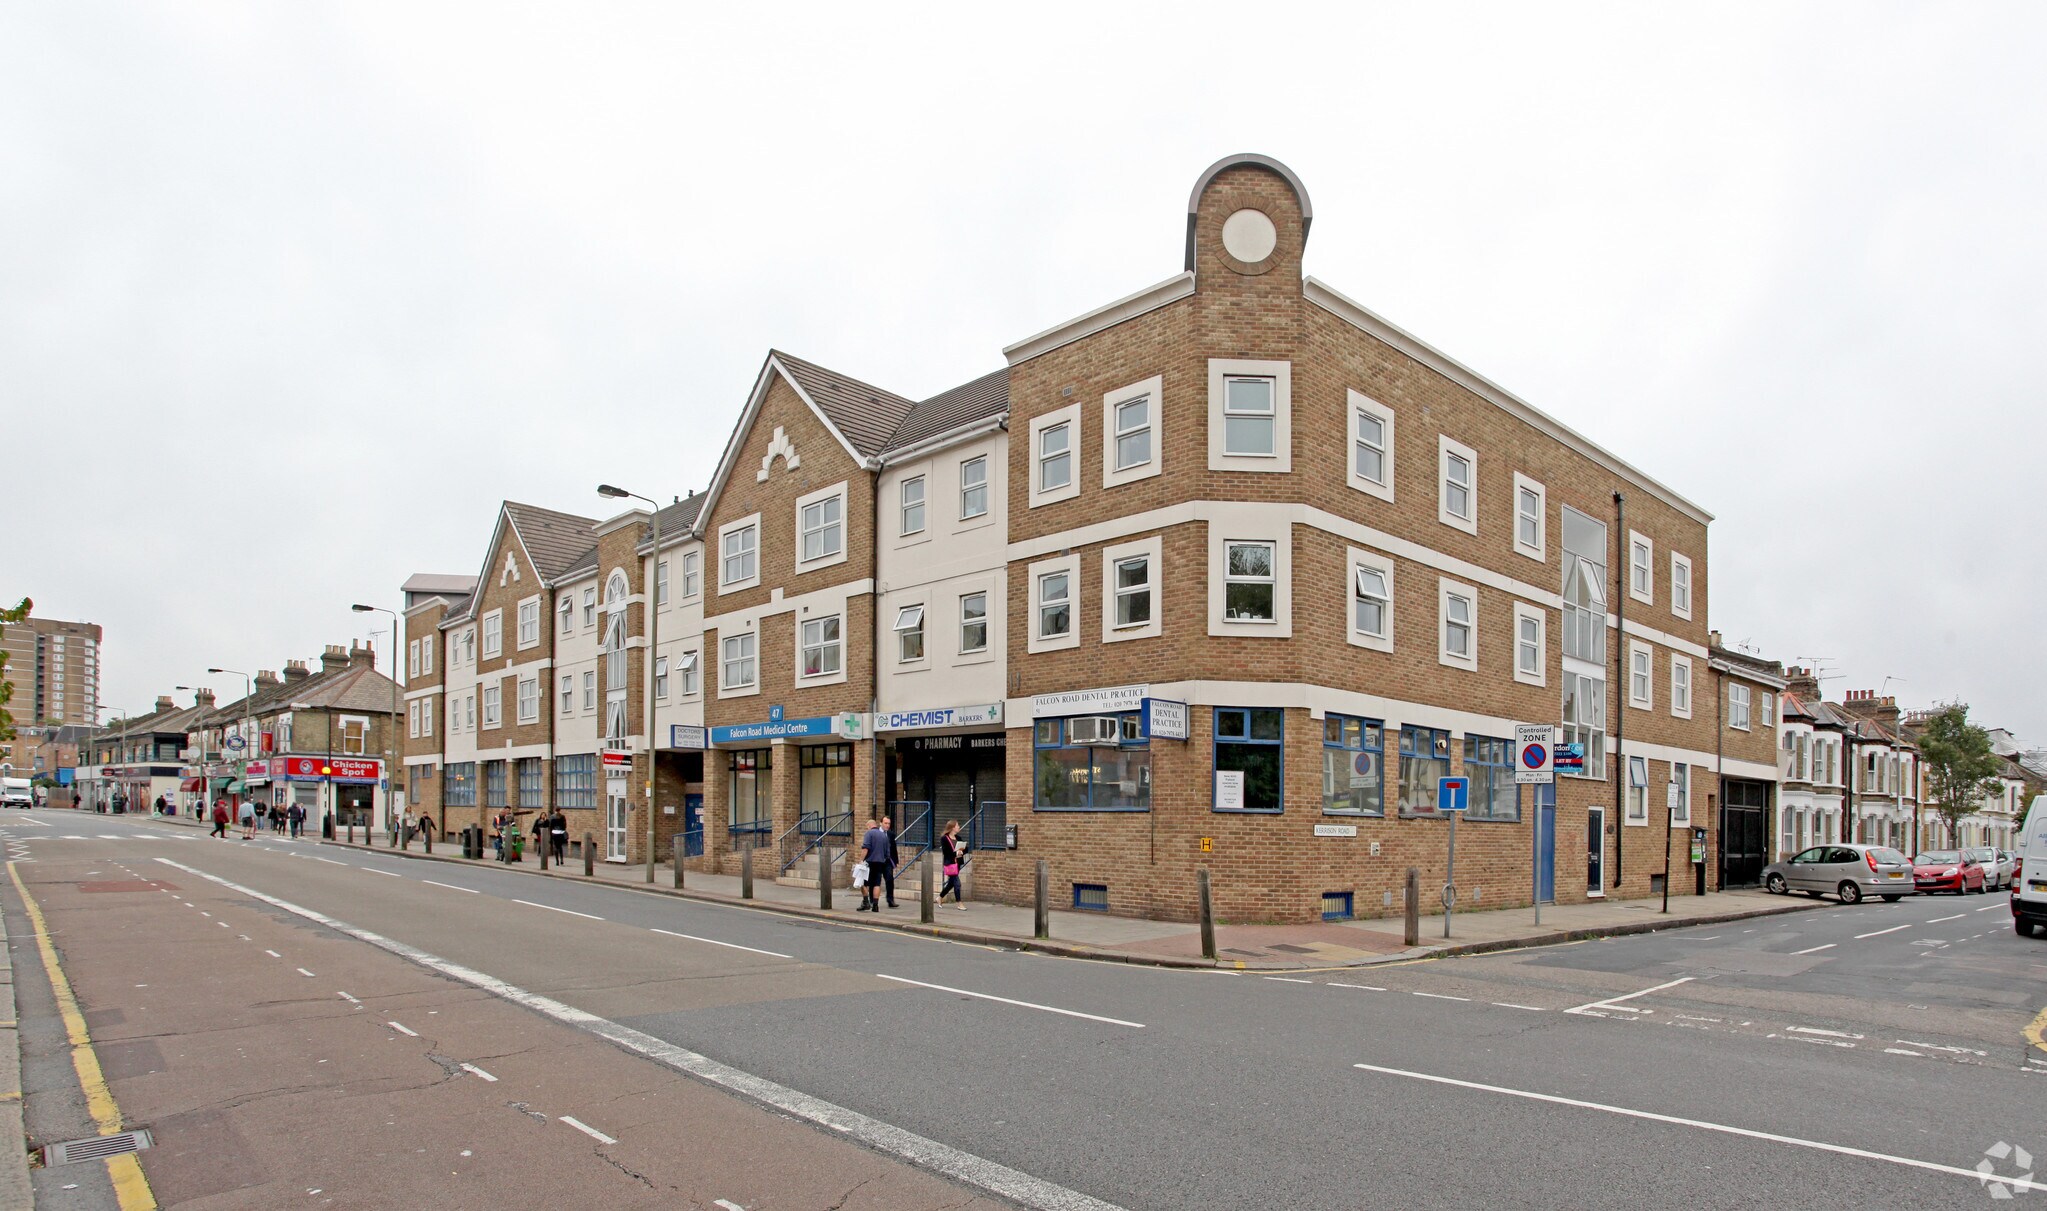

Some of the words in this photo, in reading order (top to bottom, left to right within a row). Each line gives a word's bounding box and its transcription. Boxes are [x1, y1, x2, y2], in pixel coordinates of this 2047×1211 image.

[1035, 695, 1060, 706] FALCON
[1062, 693, 1080, 703] ROAD
[1081, 691, 1108, 701] DENTAL
[1110, 688, 1144, 699] PRACTICE
[771, 708, 780, 719] 47
[890, 710, 954, 727] CHEMIST
[958, 714, 983, 723] BARKERS
[1155, 709, 1179, 719] DENTAL
[1152, 718, 1182, 728] PRACTICE
[730, 727, 747, 738] Falcon
[748, 727, 762, 737] Road
[763, 723, 786, 736] Medical
[787, 723, 808, 734] Centre
[924, 737, 962, 750] PHARMACY
[971, 739, 995, 748] BARKERS
[996, 738, 1006, 747] CHE
[332, 761, 372, 769] Chicken
[342, 768, 365, 776] Spot
[1202, 840, 1210, 849] H
